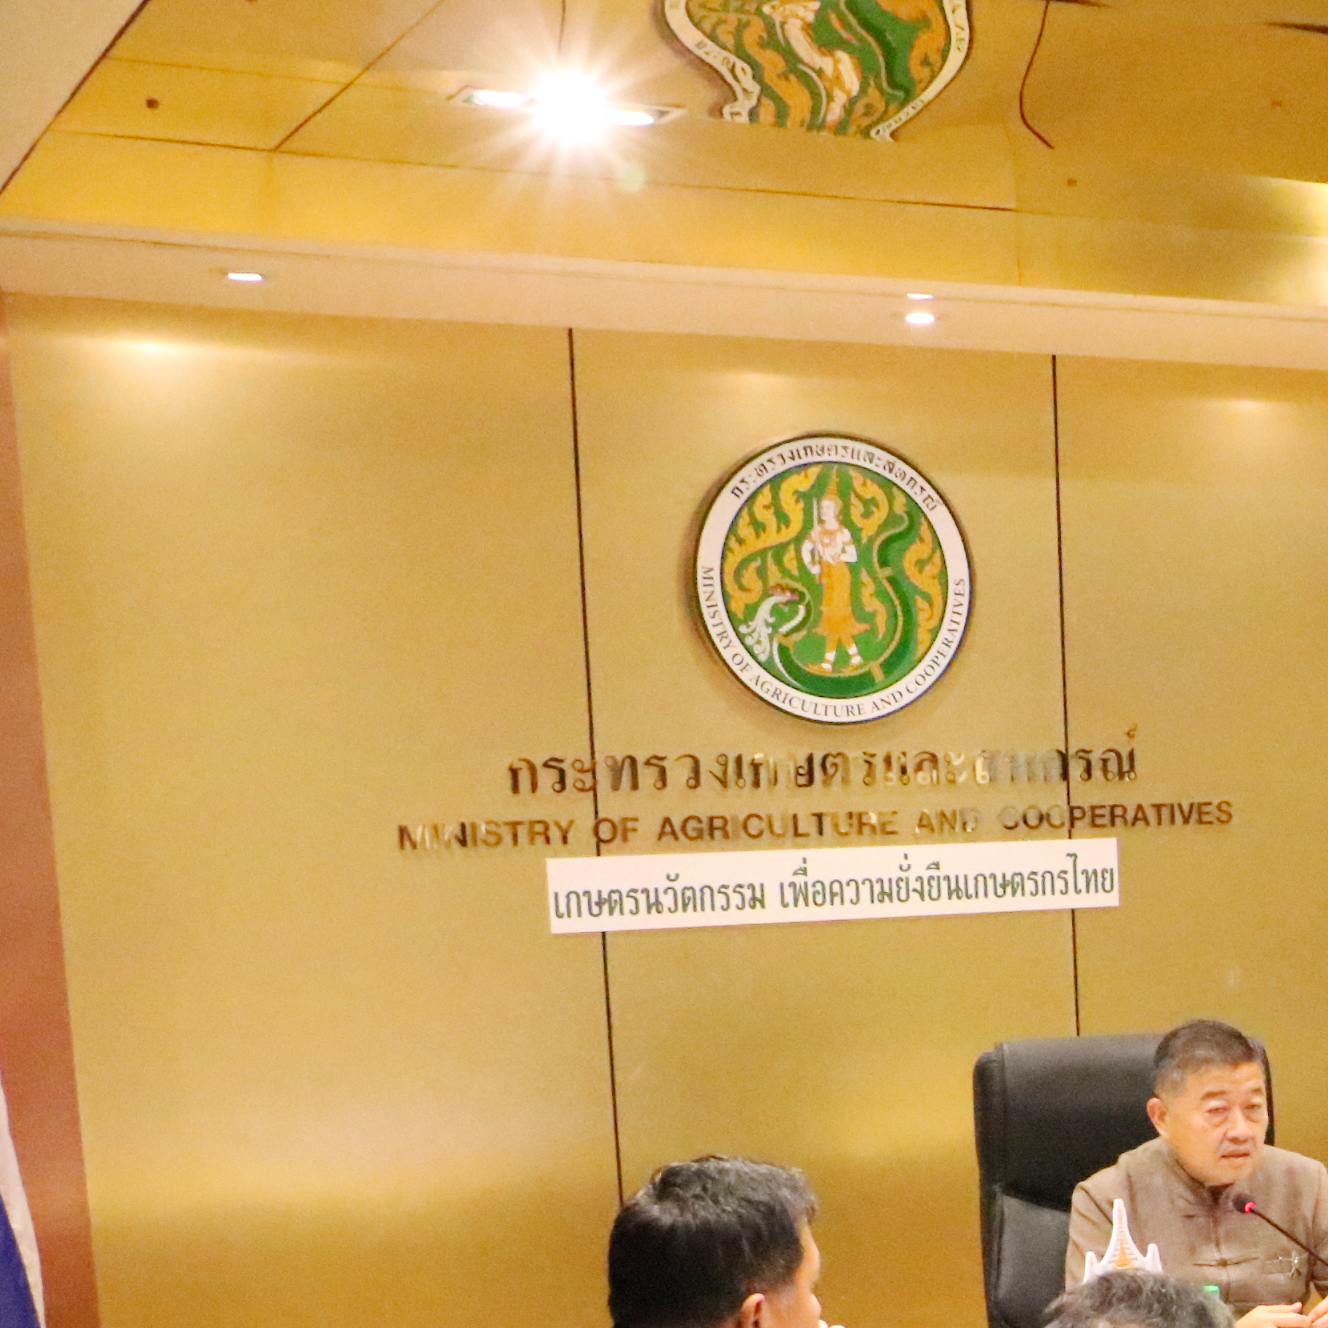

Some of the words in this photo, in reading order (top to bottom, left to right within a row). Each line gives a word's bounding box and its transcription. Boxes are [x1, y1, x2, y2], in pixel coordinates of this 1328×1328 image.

[701, 565, 735, 652] MINISTRY
[731, 652, 751, 674] OF
[750, 673, 866, 717] AGRICULTURE
[871, 690, 904, 713] AND
[905, 578, 966, 696] COOPERATIVES
[398, 818, 575, 852] MINISTRY
[594, 816, 639, 845] OF
[657, 809, 899, 844] AGRICULTURE
[915, 807, 982, 836] AND
[1001, 799, 1234, 832] COOPERATIVES
[553, 872, 765, 920] เกษตรนวัตกรรม
[779, 851, 1115, 909] เพื่อความยั่งยืนเกษตรกรไทย
